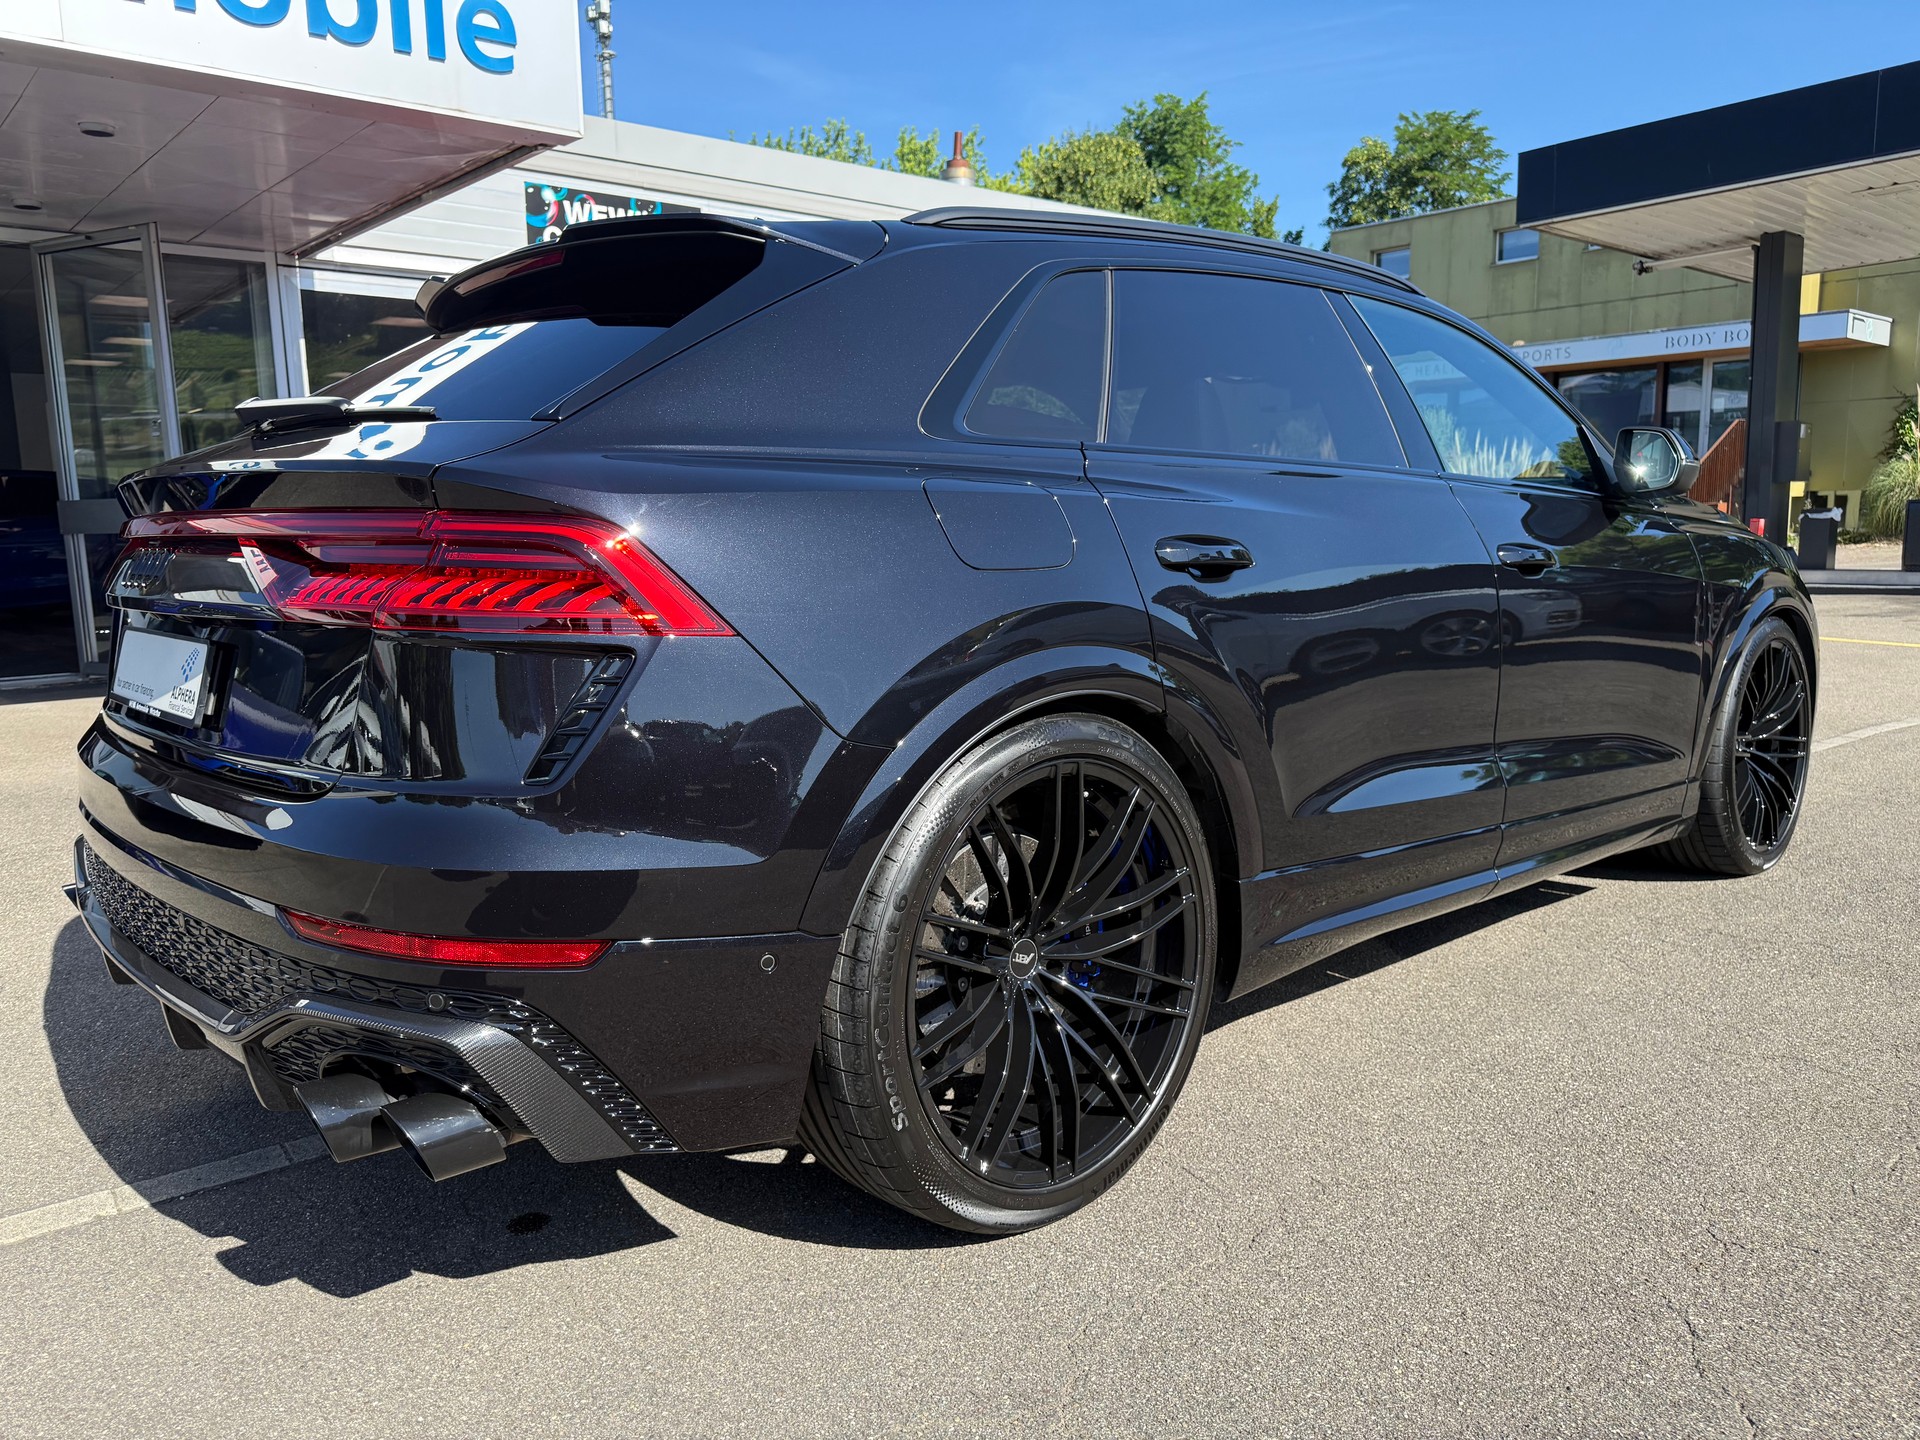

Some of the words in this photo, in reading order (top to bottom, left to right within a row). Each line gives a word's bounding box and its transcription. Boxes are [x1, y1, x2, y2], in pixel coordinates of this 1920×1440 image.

[1665, 332, 1716, 349] BODY
[1516, 346, 1572, 362] PORTS
[170, 685, 196, 705] ALPHERA
[1103, 1104, 1170, 1191] Continental
